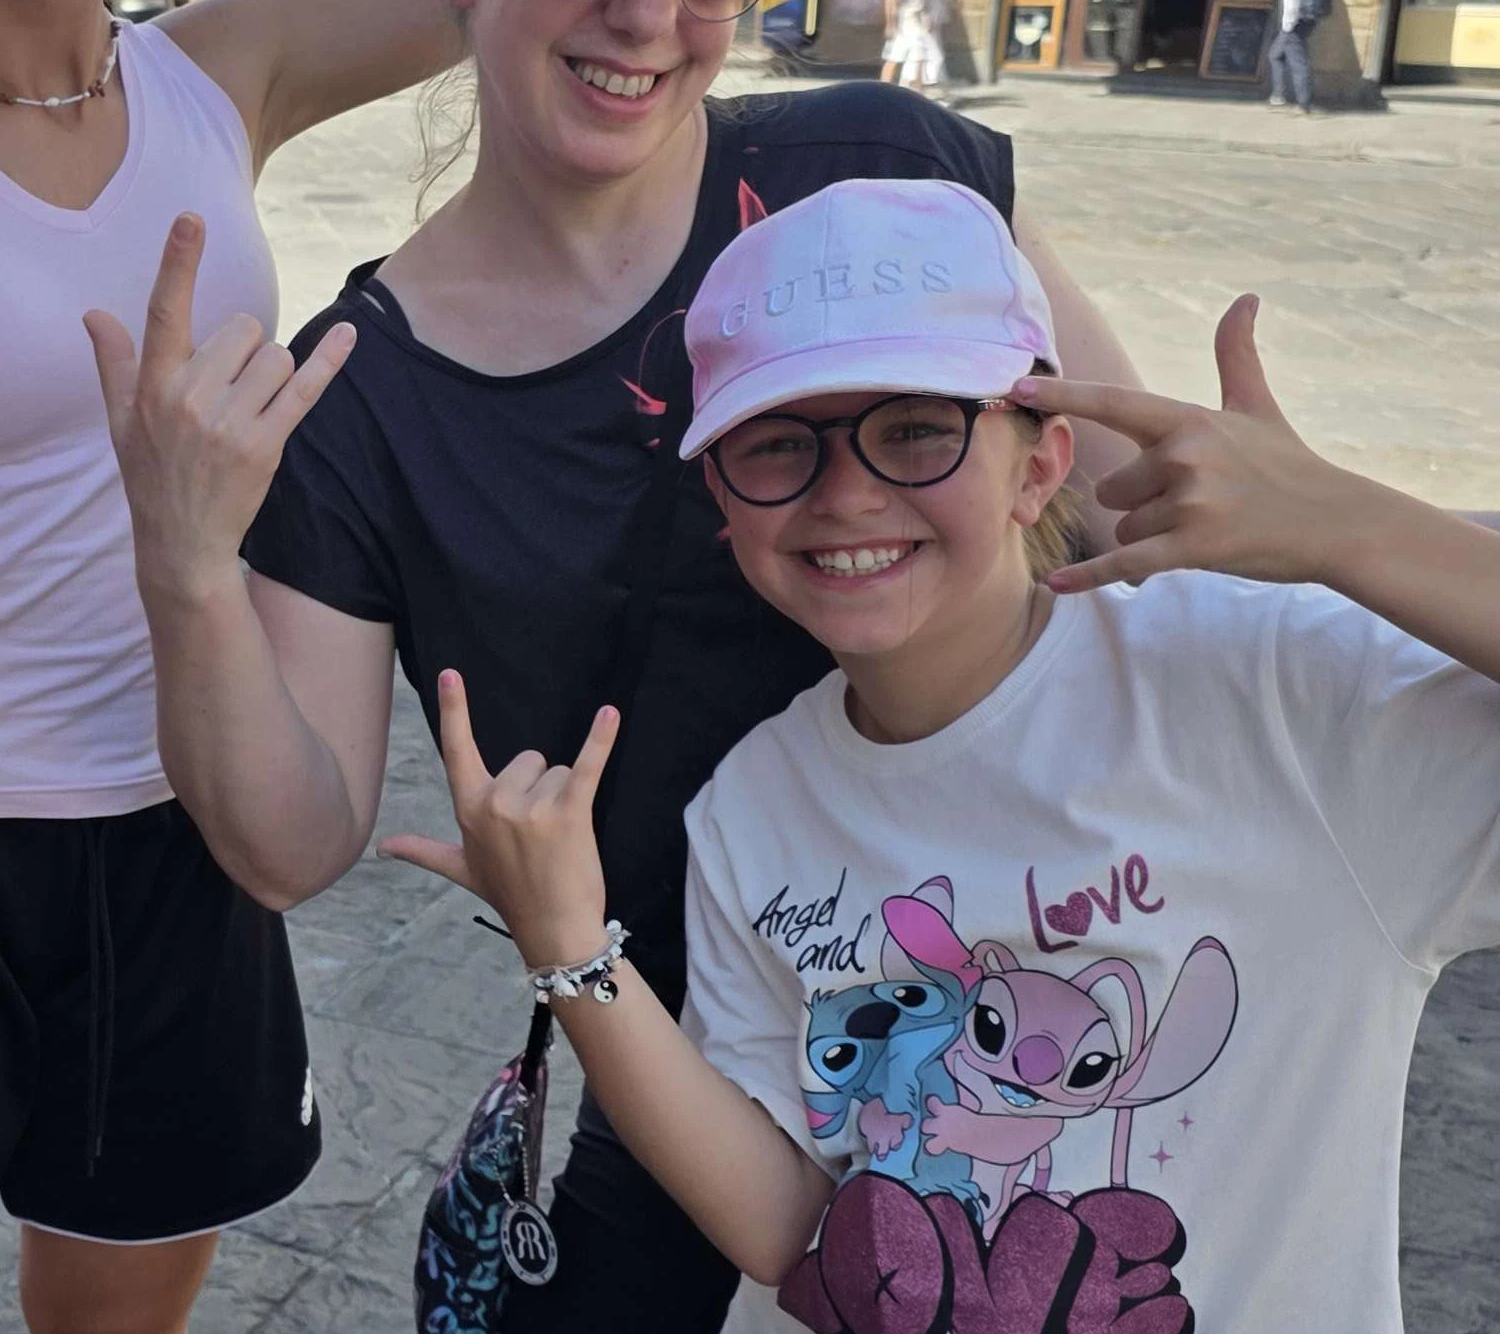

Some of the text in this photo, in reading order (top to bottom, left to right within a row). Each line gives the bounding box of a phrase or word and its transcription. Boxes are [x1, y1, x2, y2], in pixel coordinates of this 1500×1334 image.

[719, 257, 954, 340] GUESS
[752, 867, 848, 947] Angel
[796, 913, 871, 976] and
